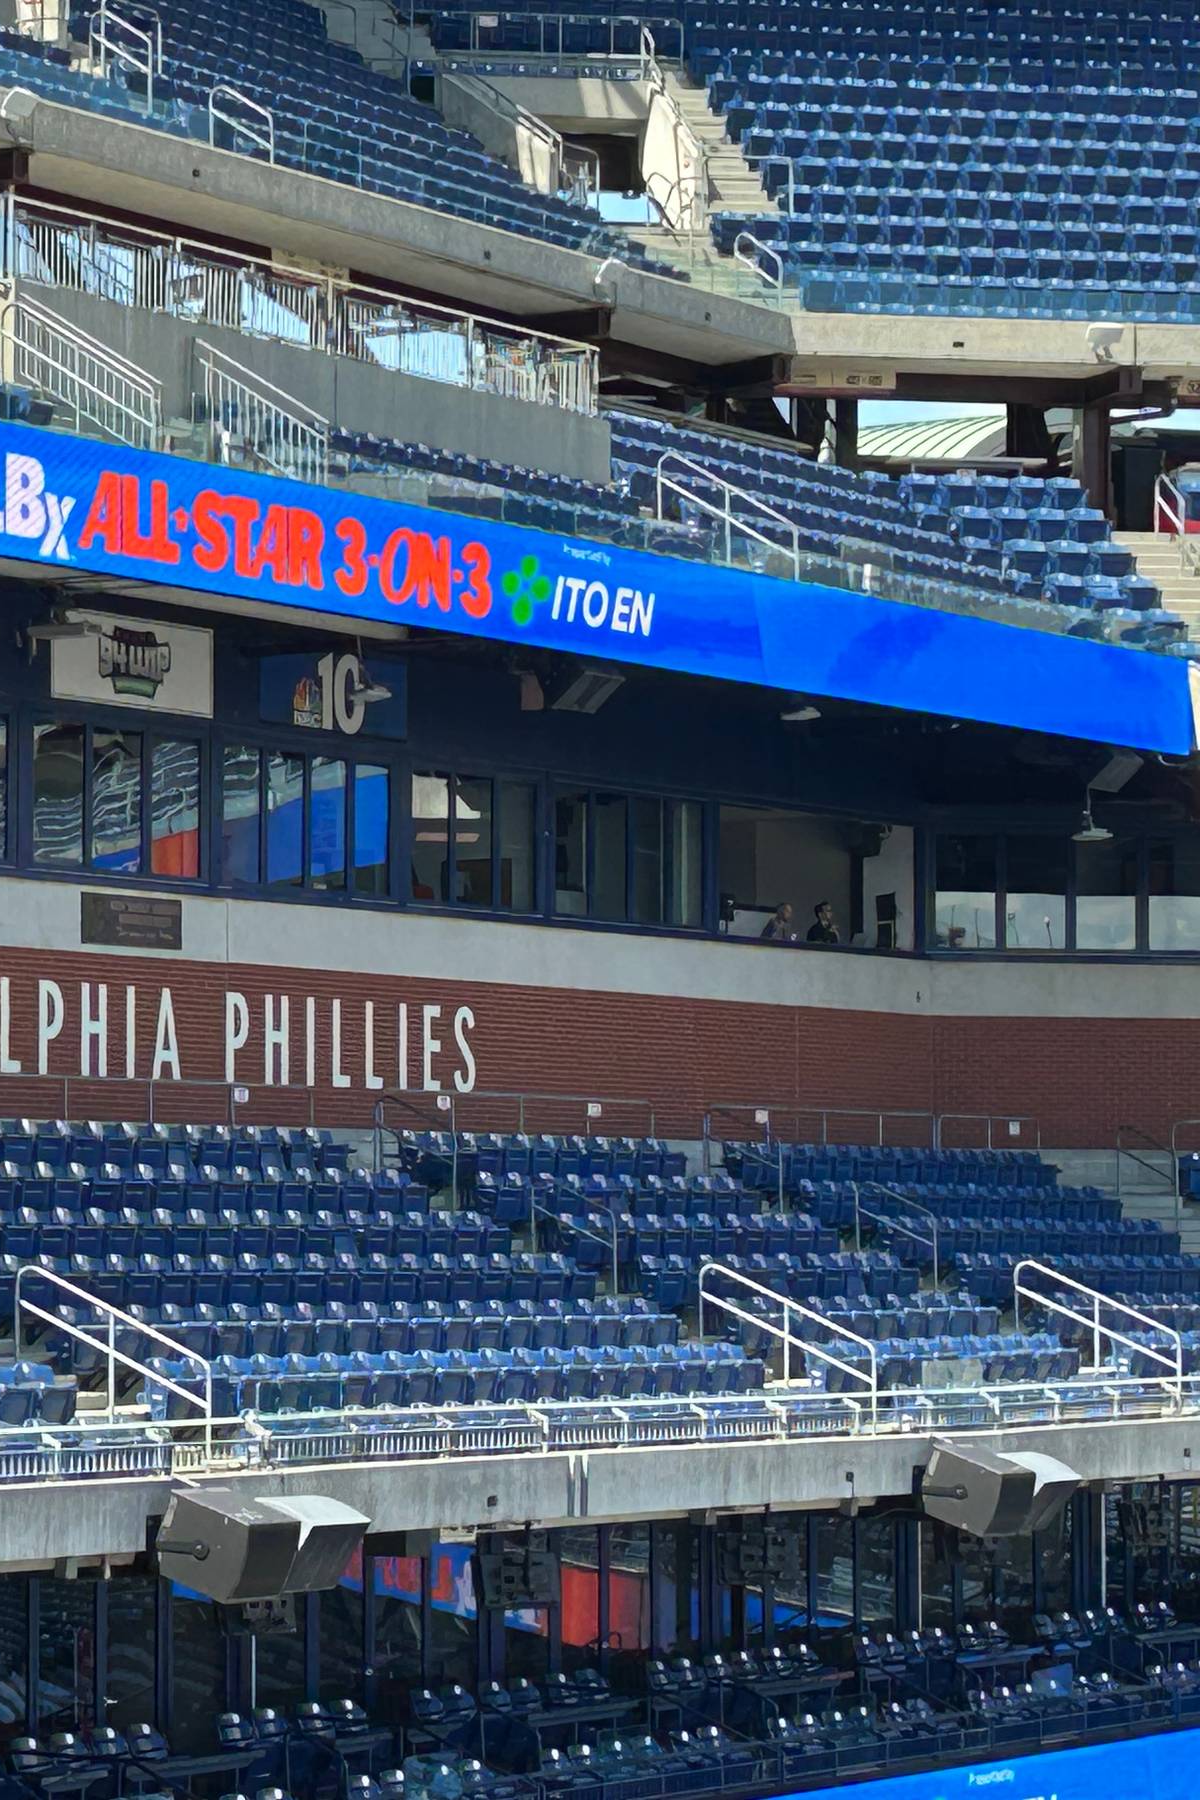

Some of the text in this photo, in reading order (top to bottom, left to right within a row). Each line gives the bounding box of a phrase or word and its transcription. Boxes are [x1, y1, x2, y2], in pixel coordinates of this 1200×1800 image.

[551, 575, 656, 637] ITO EN
[318, 652, 366, 735] 10
[225, 991, 476, 1093] PHILLIES
